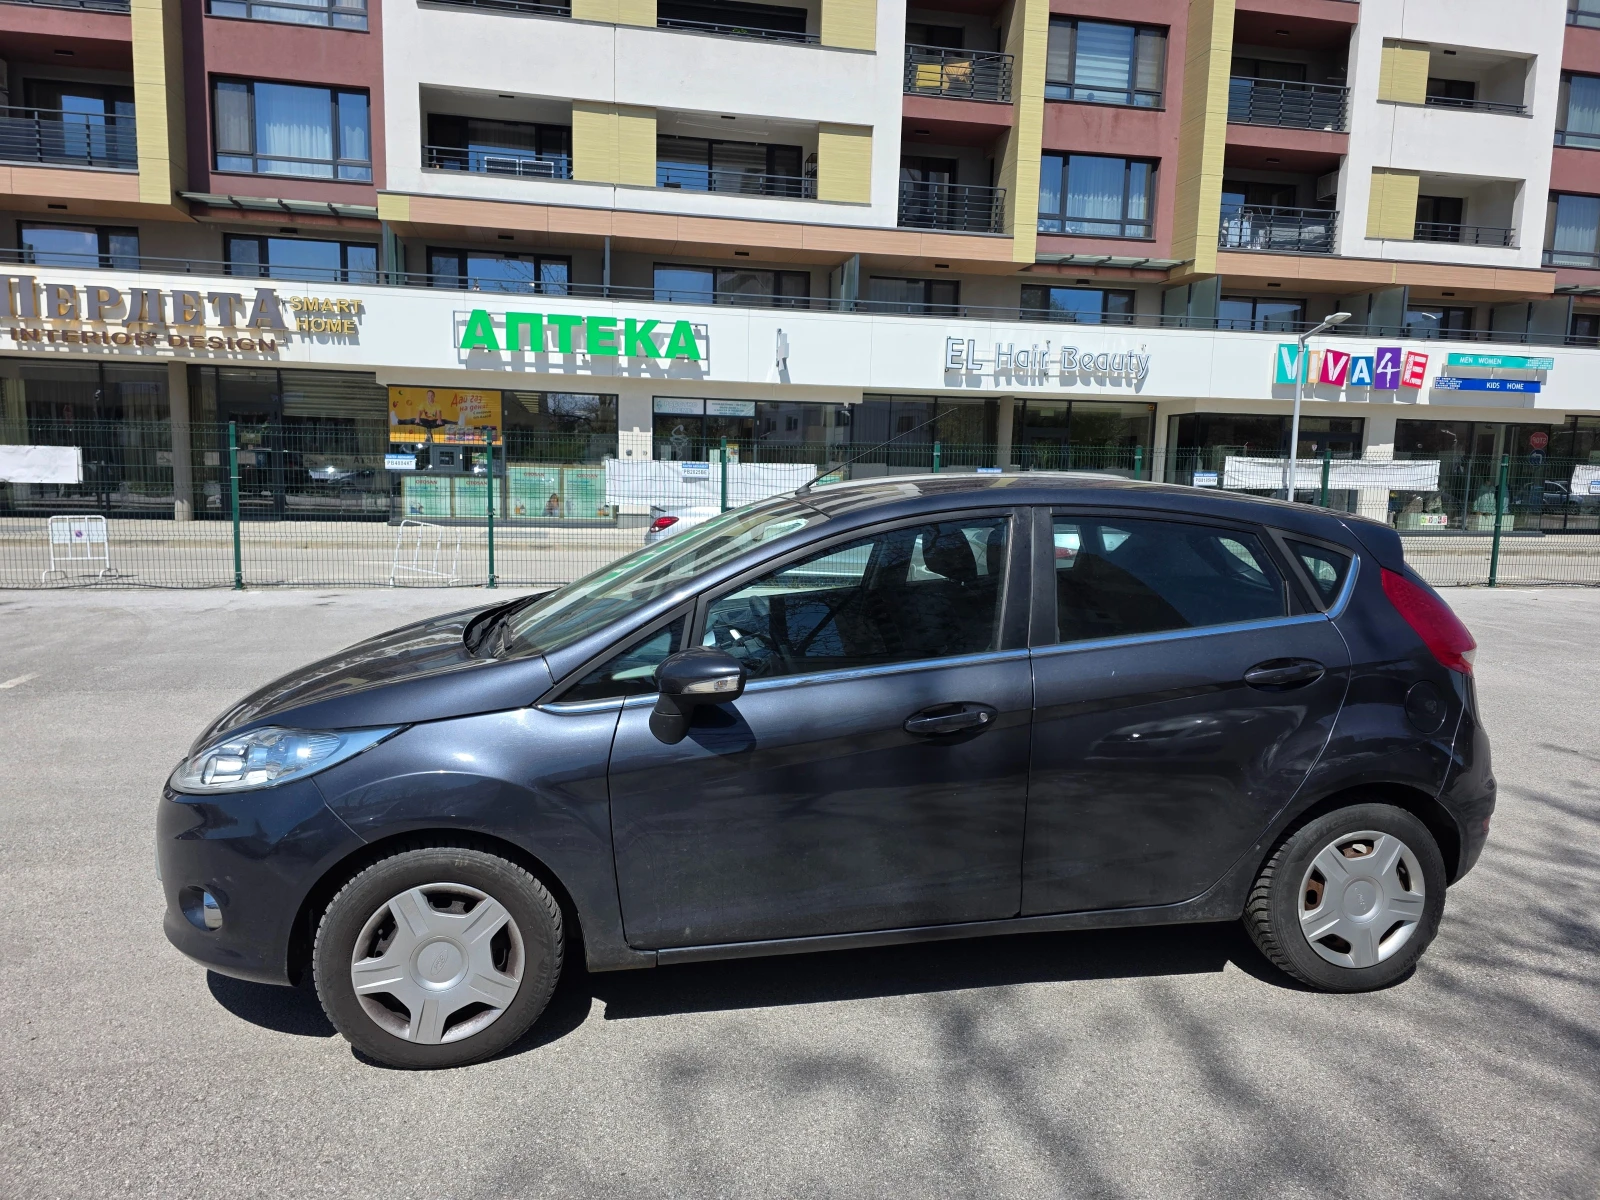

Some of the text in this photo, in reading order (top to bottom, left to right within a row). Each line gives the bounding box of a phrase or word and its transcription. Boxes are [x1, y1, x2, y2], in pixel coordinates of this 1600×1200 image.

[0, 274, 288, 331] ПЕРДЕТА
[289, 296, 362, 313] SMART
[295, 317, 356, 334] HOME
[460, 309, 701, 360] АПТЕКА
[10, 327, 276, 352] INTERIOR DESIGN
[945, 337, 1152, 379] EL Hair Beauty
[1460, 356, 1502, 365] MEN WOMEN
[1486, 381, 1501, 389] KIDS
